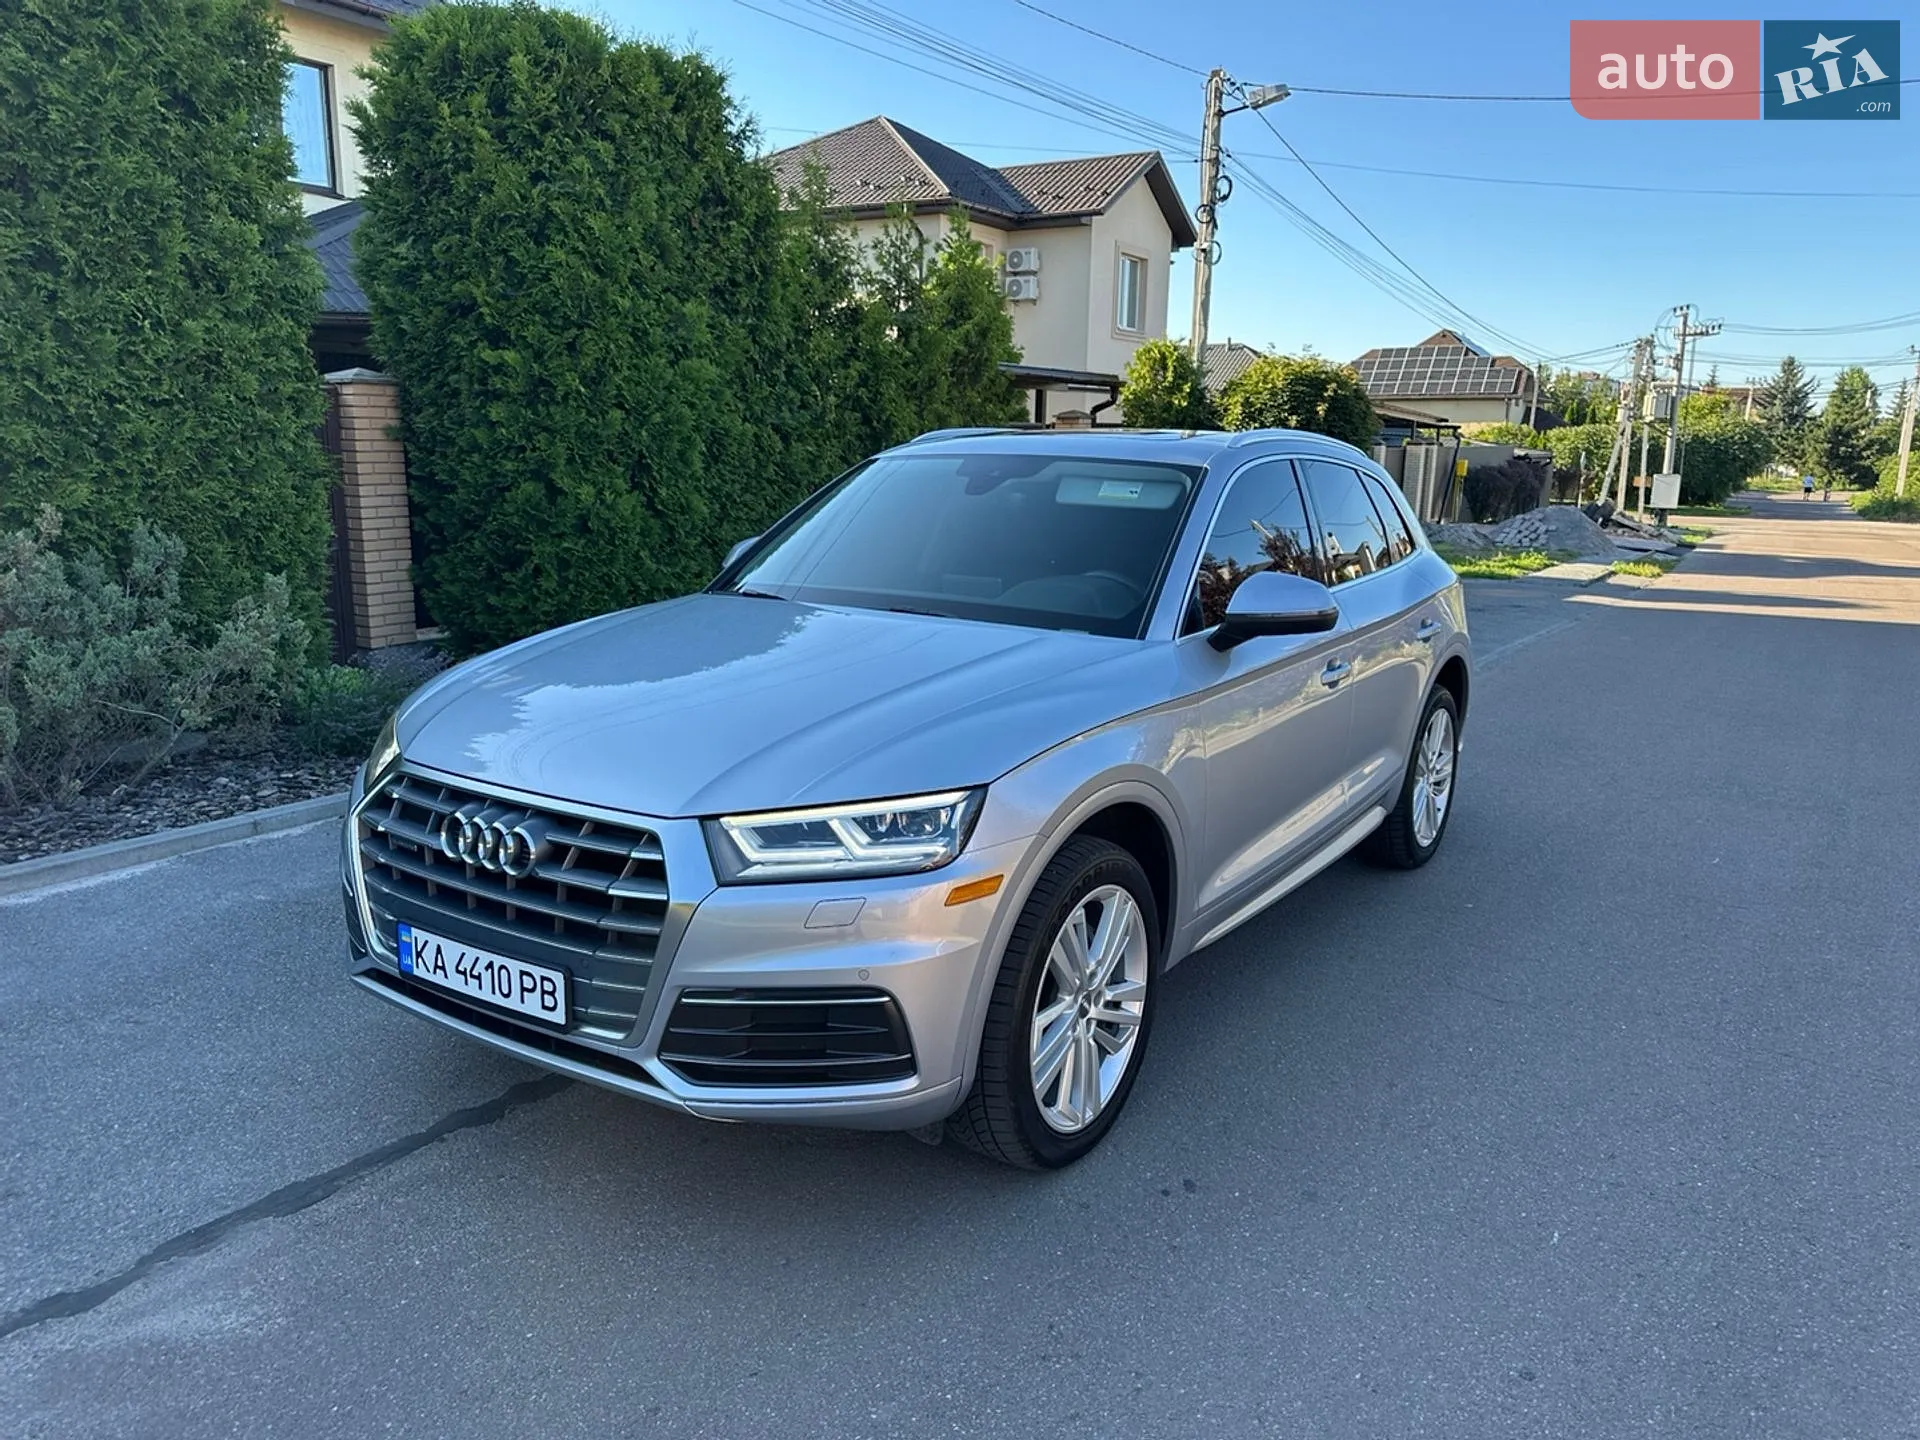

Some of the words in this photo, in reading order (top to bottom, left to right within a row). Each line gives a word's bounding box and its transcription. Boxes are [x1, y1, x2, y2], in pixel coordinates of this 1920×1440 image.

[403, 954, 412, 966] UA
[414, 936, 448, 979] KA
[455, 952, 512, 998] 4410
[519, 969, 558, 1012] PB
